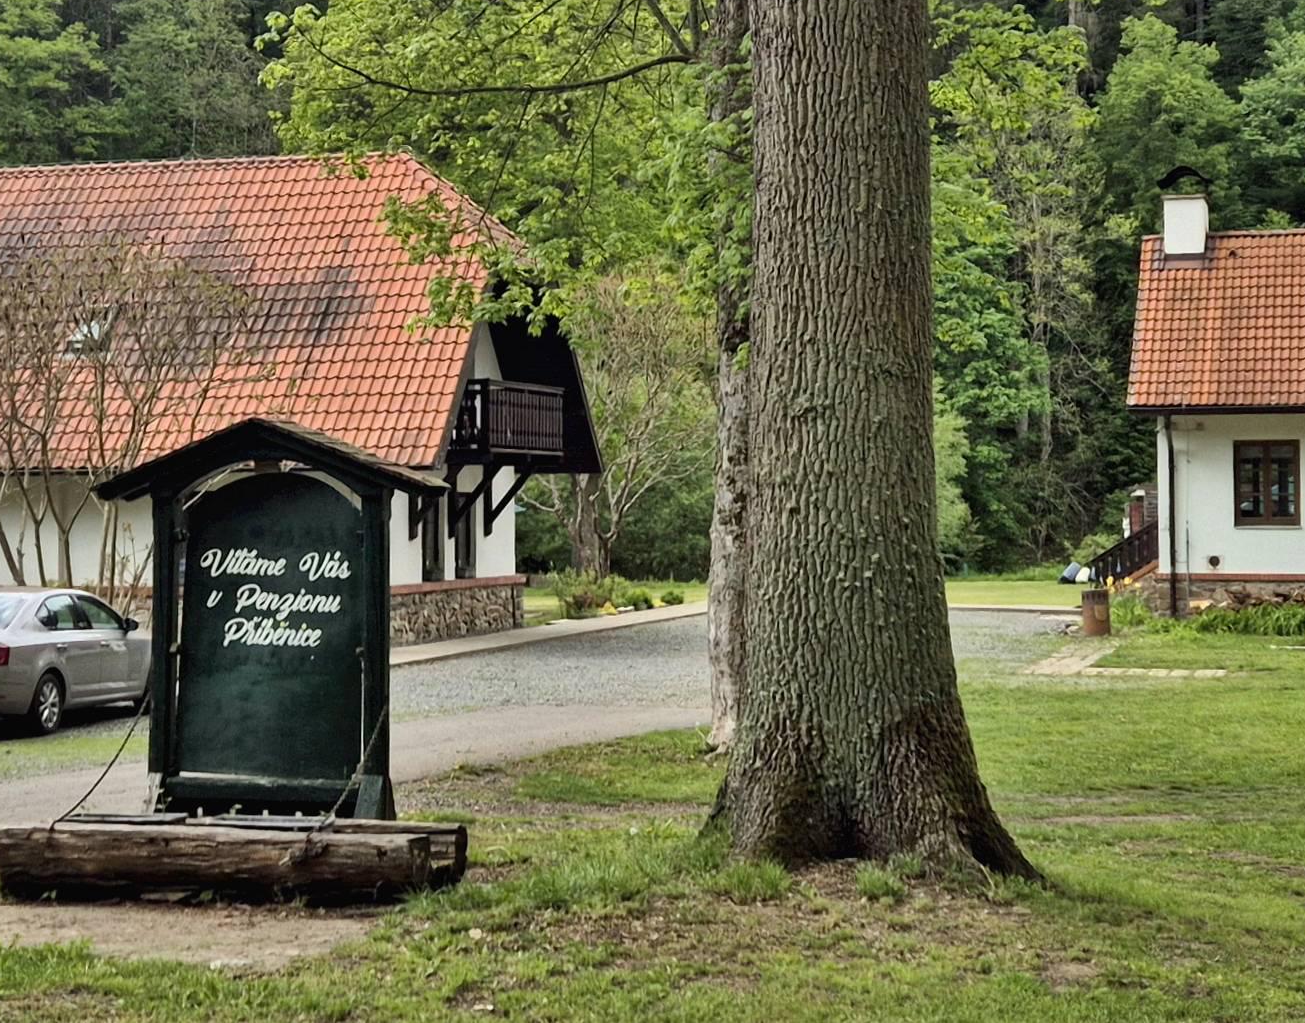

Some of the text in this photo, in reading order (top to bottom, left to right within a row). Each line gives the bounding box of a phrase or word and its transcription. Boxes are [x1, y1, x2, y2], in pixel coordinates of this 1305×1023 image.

[298, 550, 352, 582] Vás
[206, 583, 342, 621] v Penzionu
[222, 616, 322, 647] Příběnice
